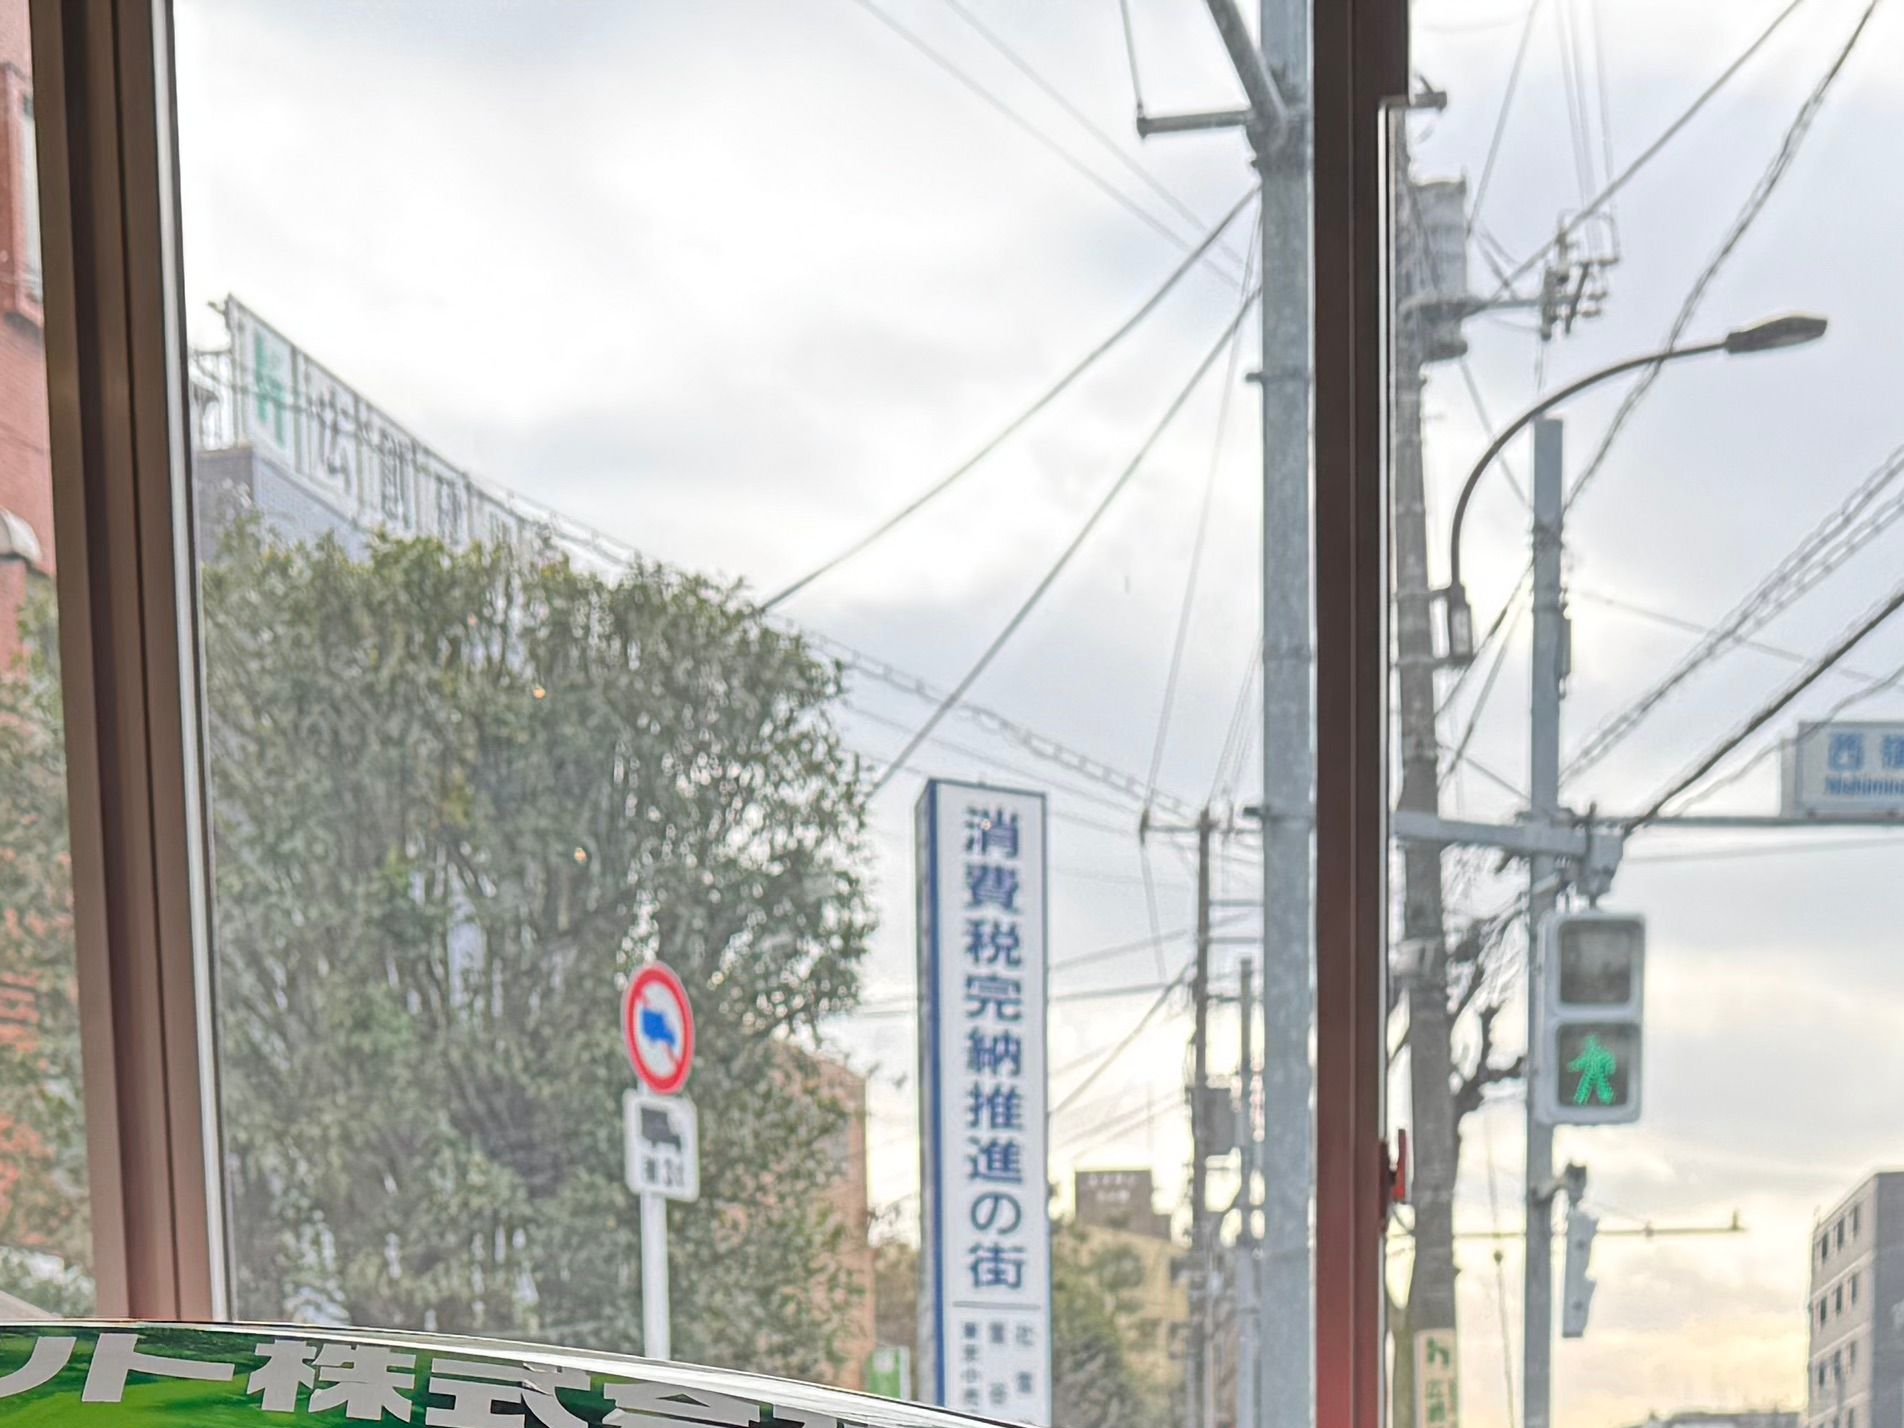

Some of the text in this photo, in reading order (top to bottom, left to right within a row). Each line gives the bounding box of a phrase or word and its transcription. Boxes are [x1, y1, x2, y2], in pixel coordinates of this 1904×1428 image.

[963, 806, 1027, 1290] 消費税完納推進の街
